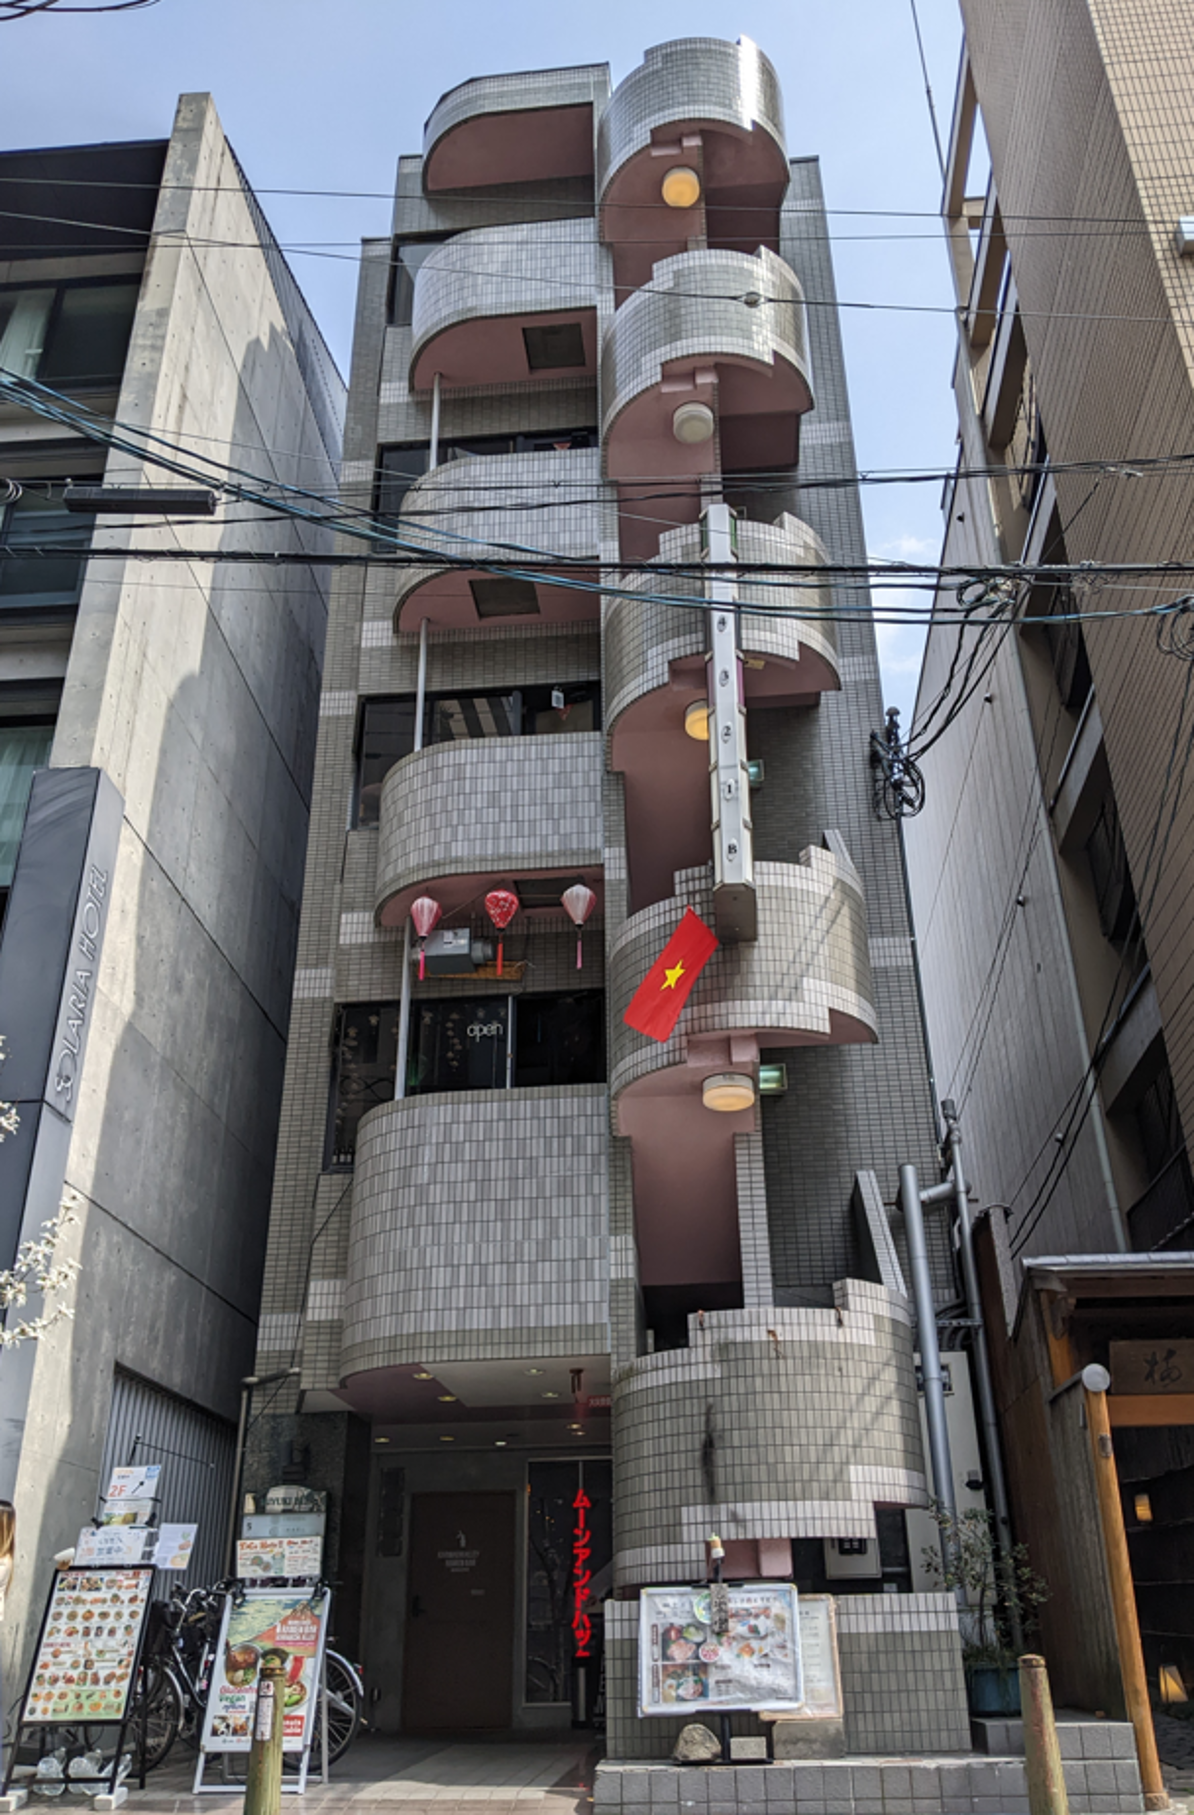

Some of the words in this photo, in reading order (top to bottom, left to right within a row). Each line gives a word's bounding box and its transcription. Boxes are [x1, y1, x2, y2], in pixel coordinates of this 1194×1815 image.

[723, 725, 731, 736] 2
[728, 844, 737, 855] B
[55, 968, 92, 1103] SOLARIA
[78, 865, 108, 961] HOTEL
[467, 1023, 503, 1042] open
[108, 1485, 127, 1498] 2F
